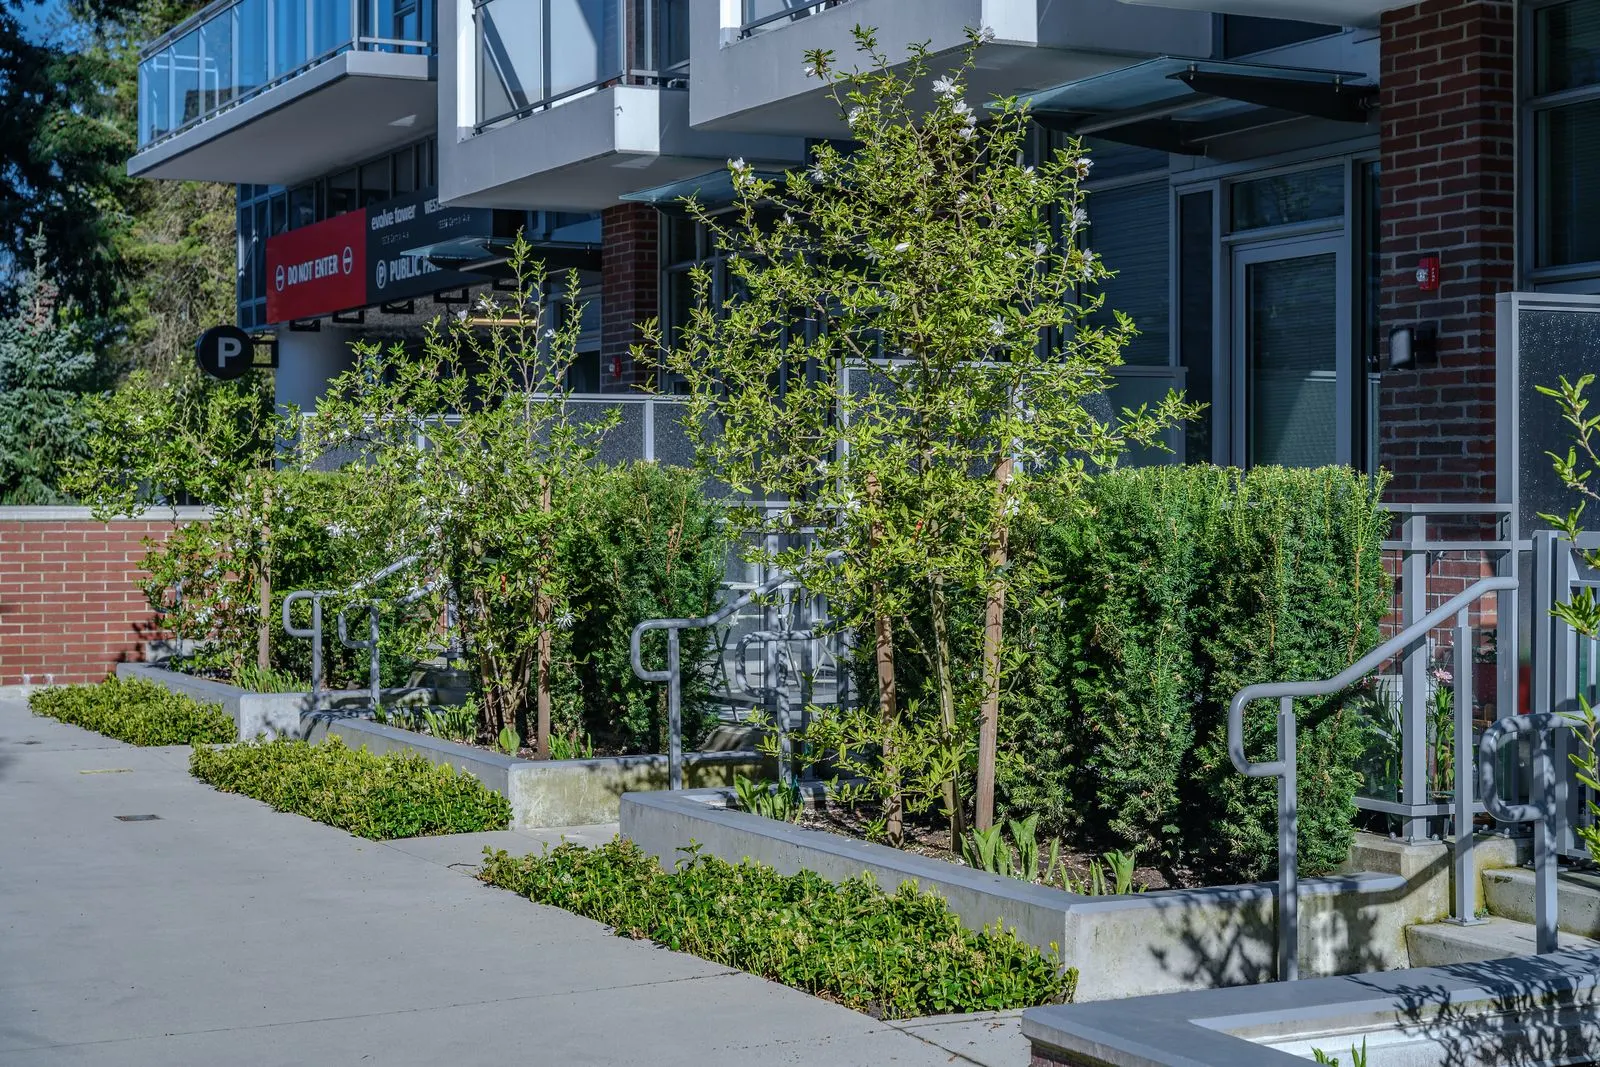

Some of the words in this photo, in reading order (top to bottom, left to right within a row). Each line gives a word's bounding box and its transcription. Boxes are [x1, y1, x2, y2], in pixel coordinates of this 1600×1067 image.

[371, 208, 394, 231] evolve
[394, 204, 416, 223] tower
[287, 265, 298, 286] DO
[298, 261, 314, 283] NOT
[315, 254, 339, 279] ENTER
[389, 255, 421, 282] PUBLIC
[217, 336, 242, 367] P
